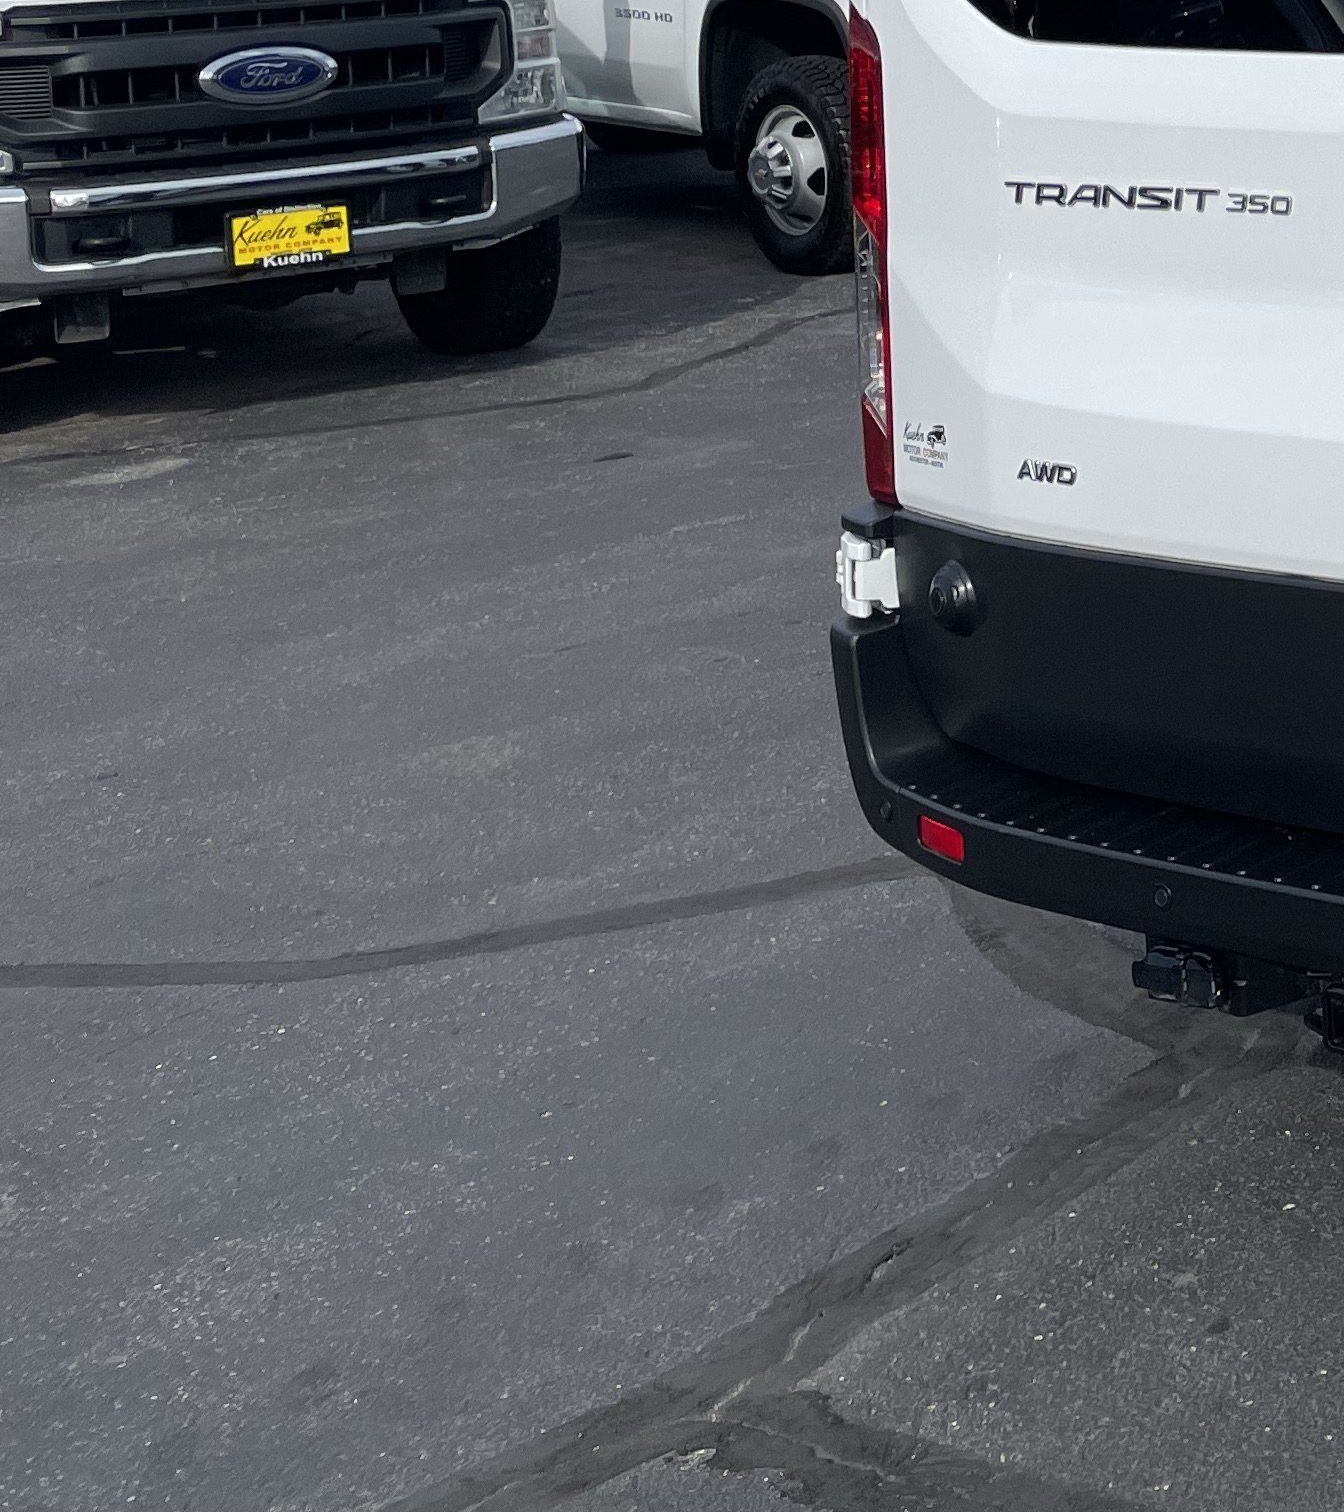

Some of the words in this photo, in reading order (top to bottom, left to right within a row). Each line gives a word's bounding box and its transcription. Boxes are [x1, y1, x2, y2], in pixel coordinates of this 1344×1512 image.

[615, 7, 651, 20] 3500
[655, 12, 673, 23] HD
[239, 61, 304, 90] Ford
[1004, 181, 1221, 213] TRANSIT
[1225, 192, 1293, 217] 350
[234, 215, 298, 246] Kuehn
[238, 243, 281, 255] MOTOR
[285, 235, 343, 250] COMPANY
[262, 251, 324, 268] Kuehn
[1016, 458, 1078, 486] AWD
